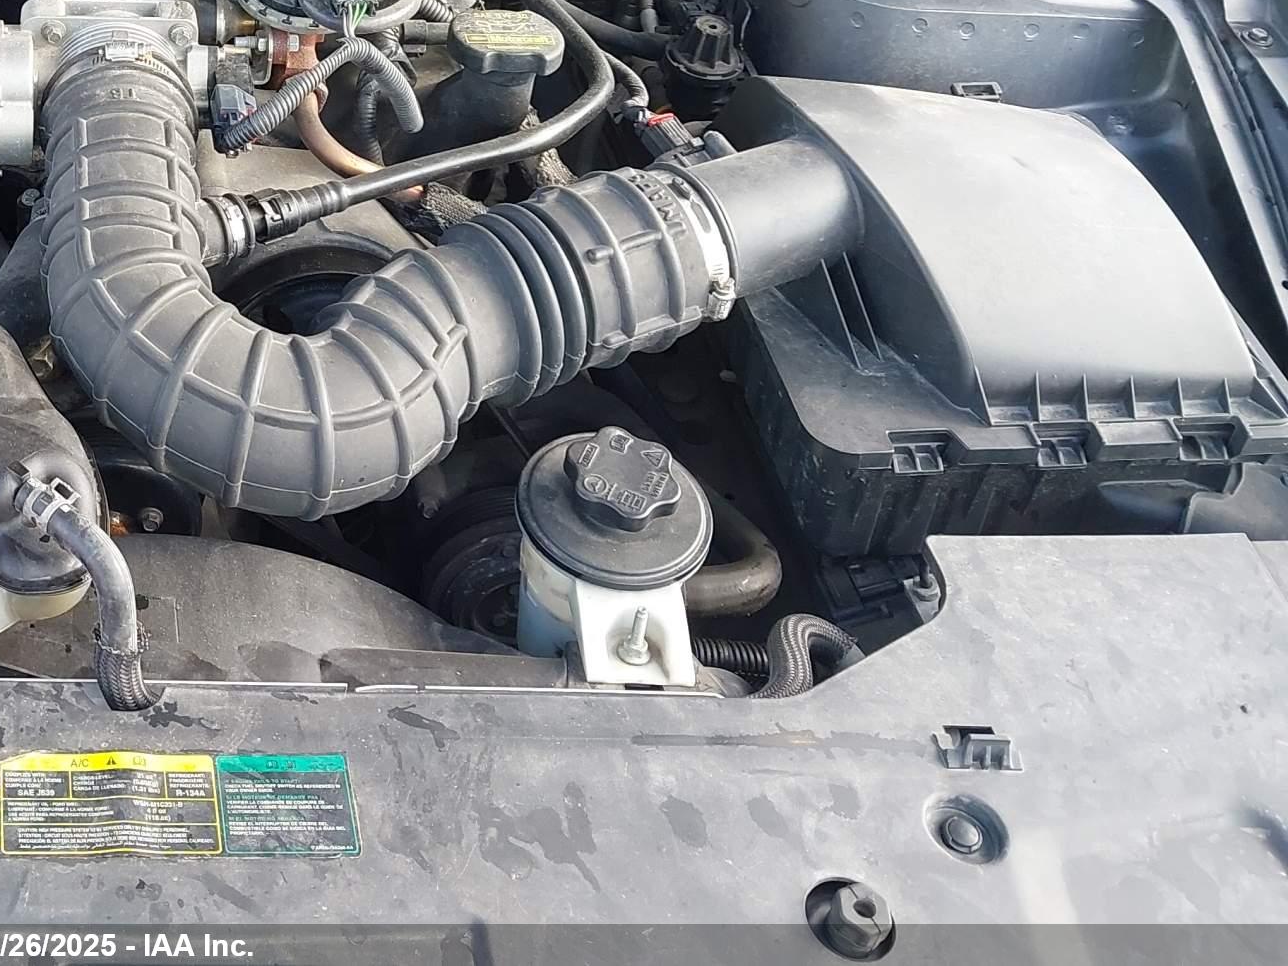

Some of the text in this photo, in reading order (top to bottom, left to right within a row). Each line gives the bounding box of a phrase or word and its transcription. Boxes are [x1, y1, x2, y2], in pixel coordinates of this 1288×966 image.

[71, 758, 89, 768] A/C
[17, 789, 35, 797] SAE
[175, 789, 206, 797] R-134A
